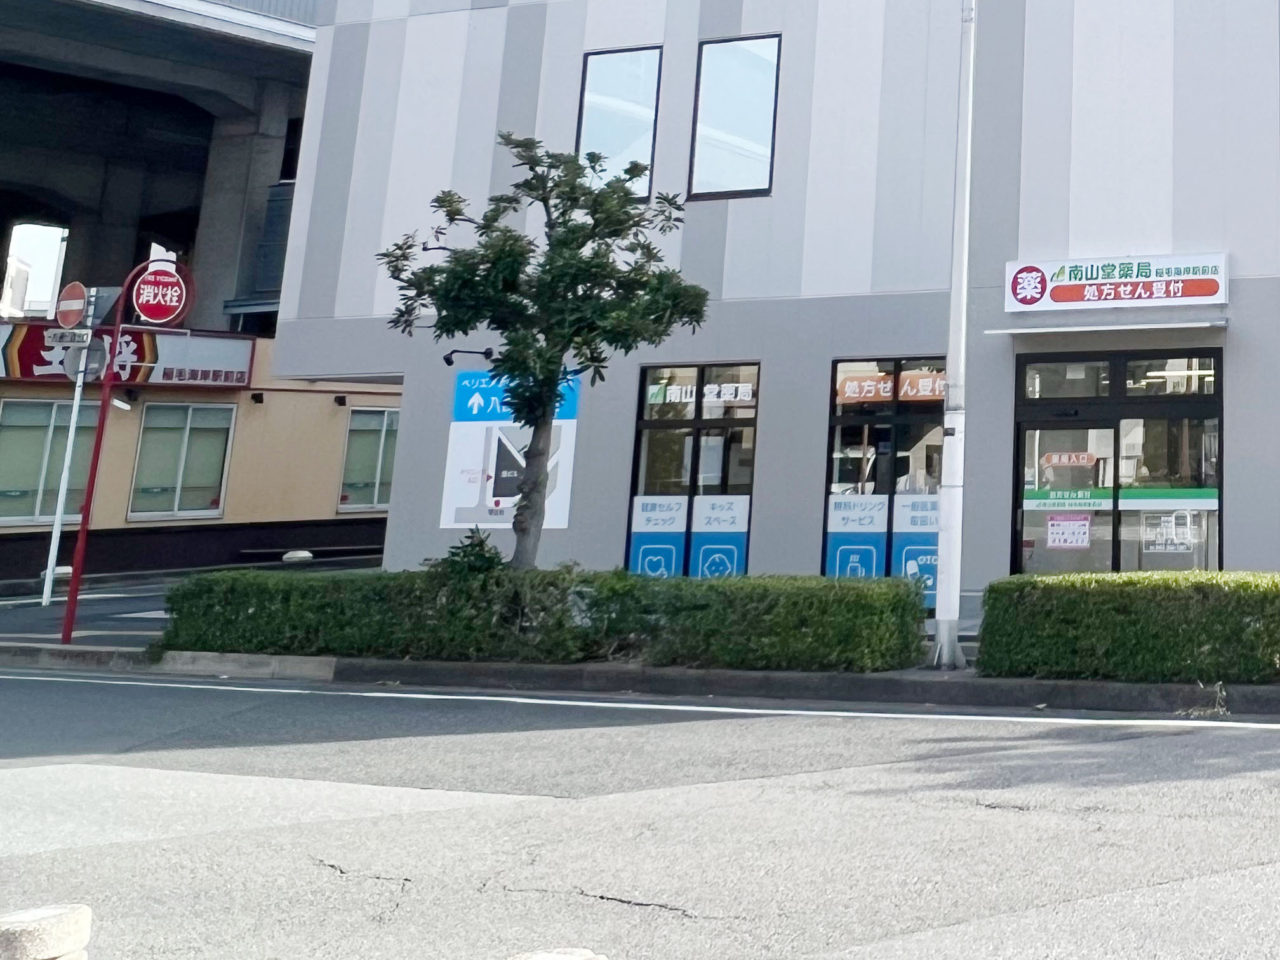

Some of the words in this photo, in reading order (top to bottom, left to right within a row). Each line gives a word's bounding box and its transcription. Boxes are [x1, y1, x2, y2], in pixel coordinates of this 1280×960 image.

[1068, 262, 1152, 282] 南山堂薬局
[139, 285, 180, 305] 消火栓
[1016, 271, 1042, 299] 薬
[1083, 280, 1184, 300] 処方せん受付
